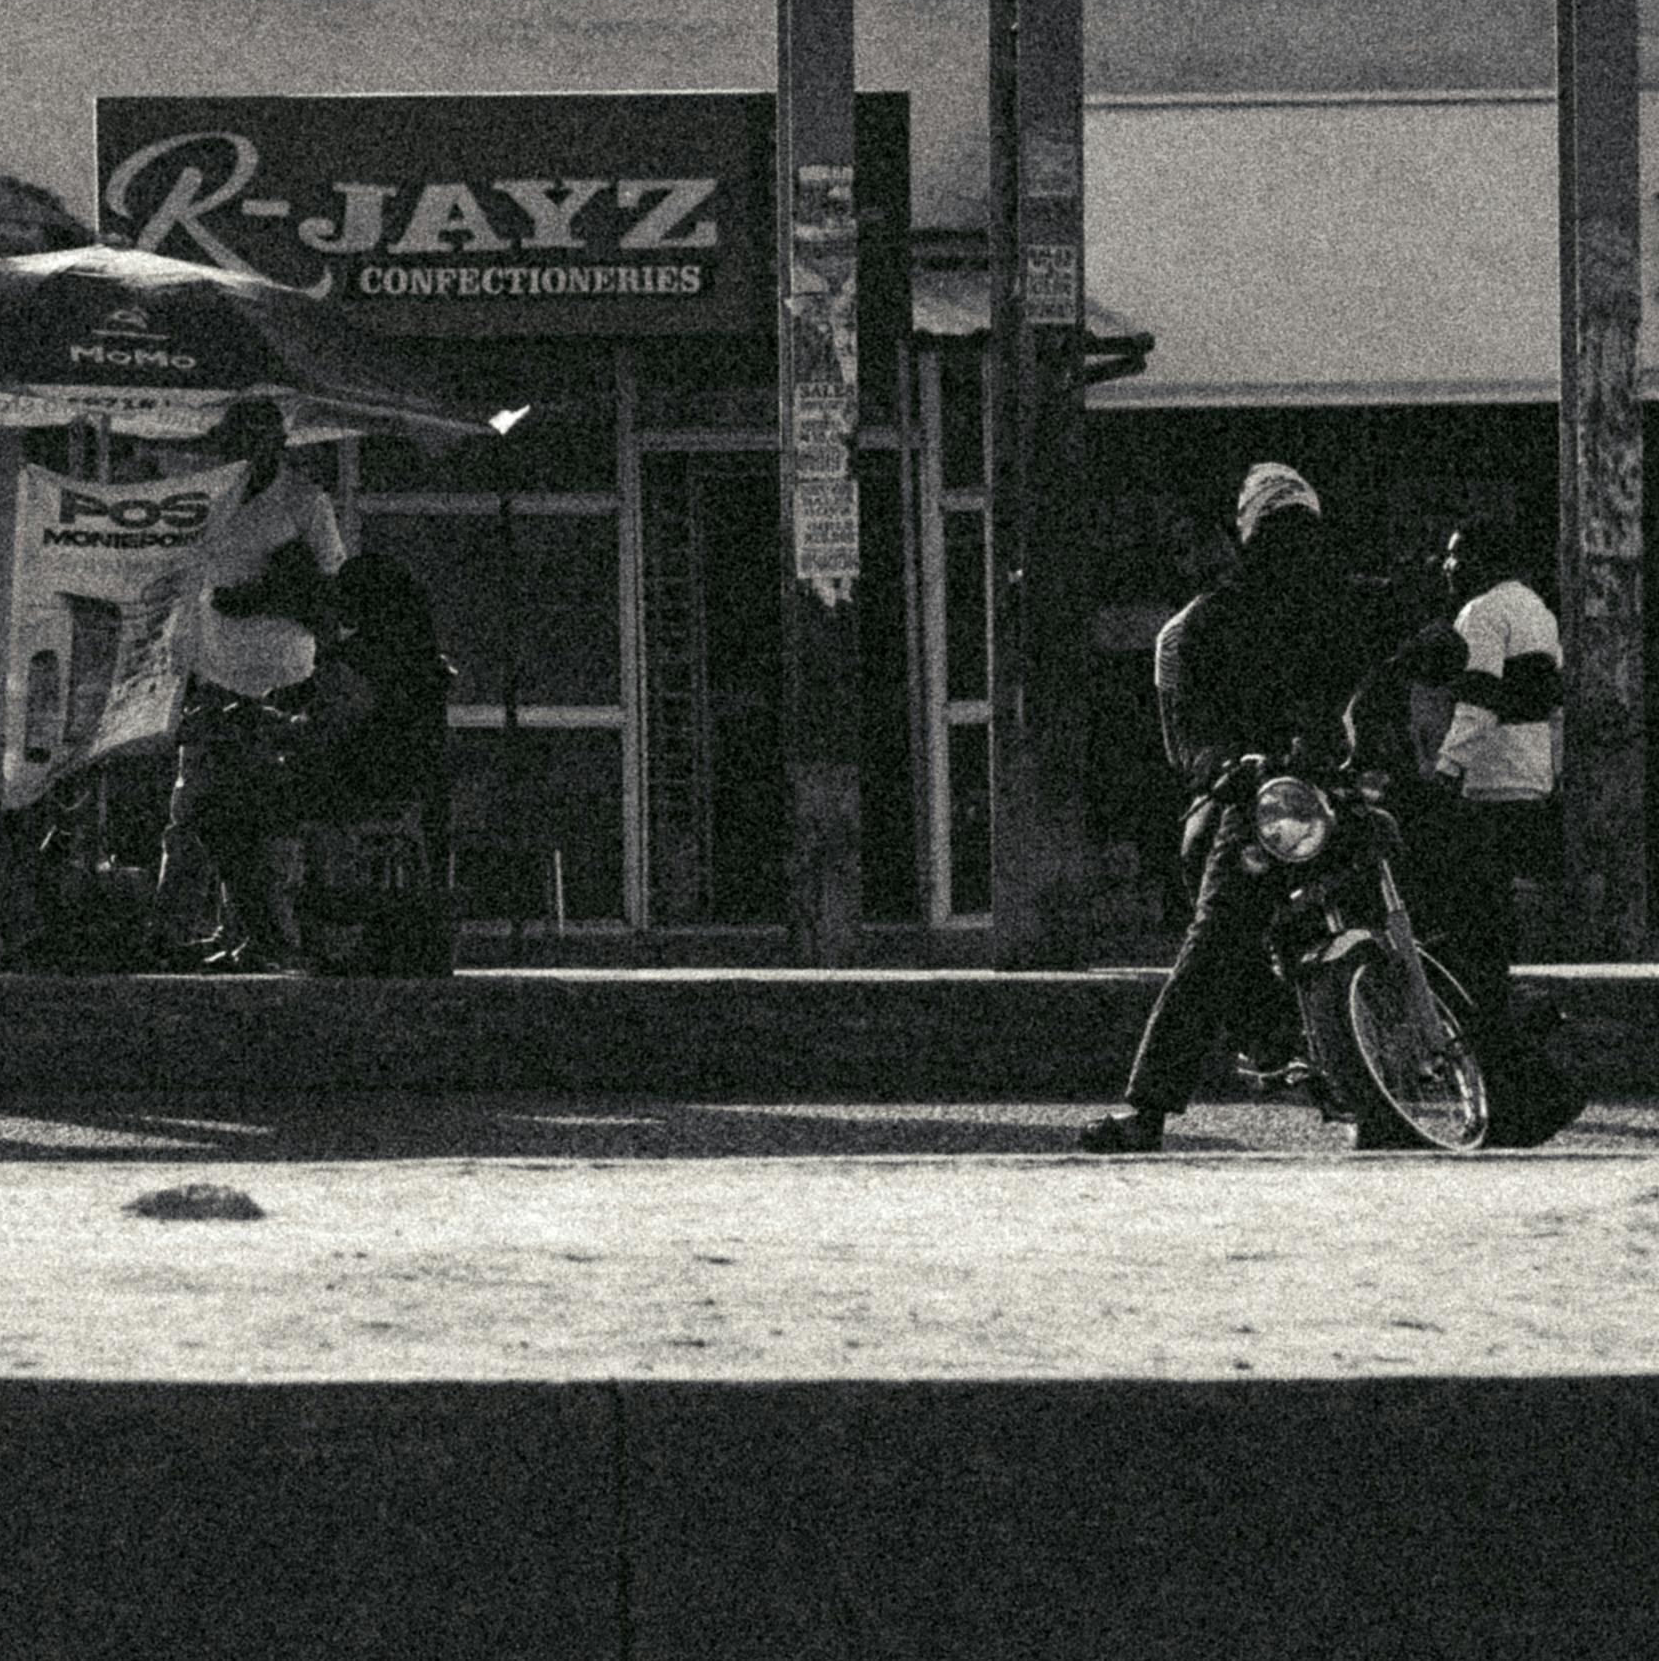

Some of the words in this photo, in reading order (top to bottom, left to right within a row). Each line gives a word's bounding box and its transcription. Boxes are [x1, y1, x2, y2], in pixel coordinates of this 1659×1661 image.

[106, 131, 718, 301] R-JAYZ
[361, 265, 701, 296] CONFECTIONERIES
[70, 344, 197, 370] MoMo
[59, 488, 211, 529] POS
